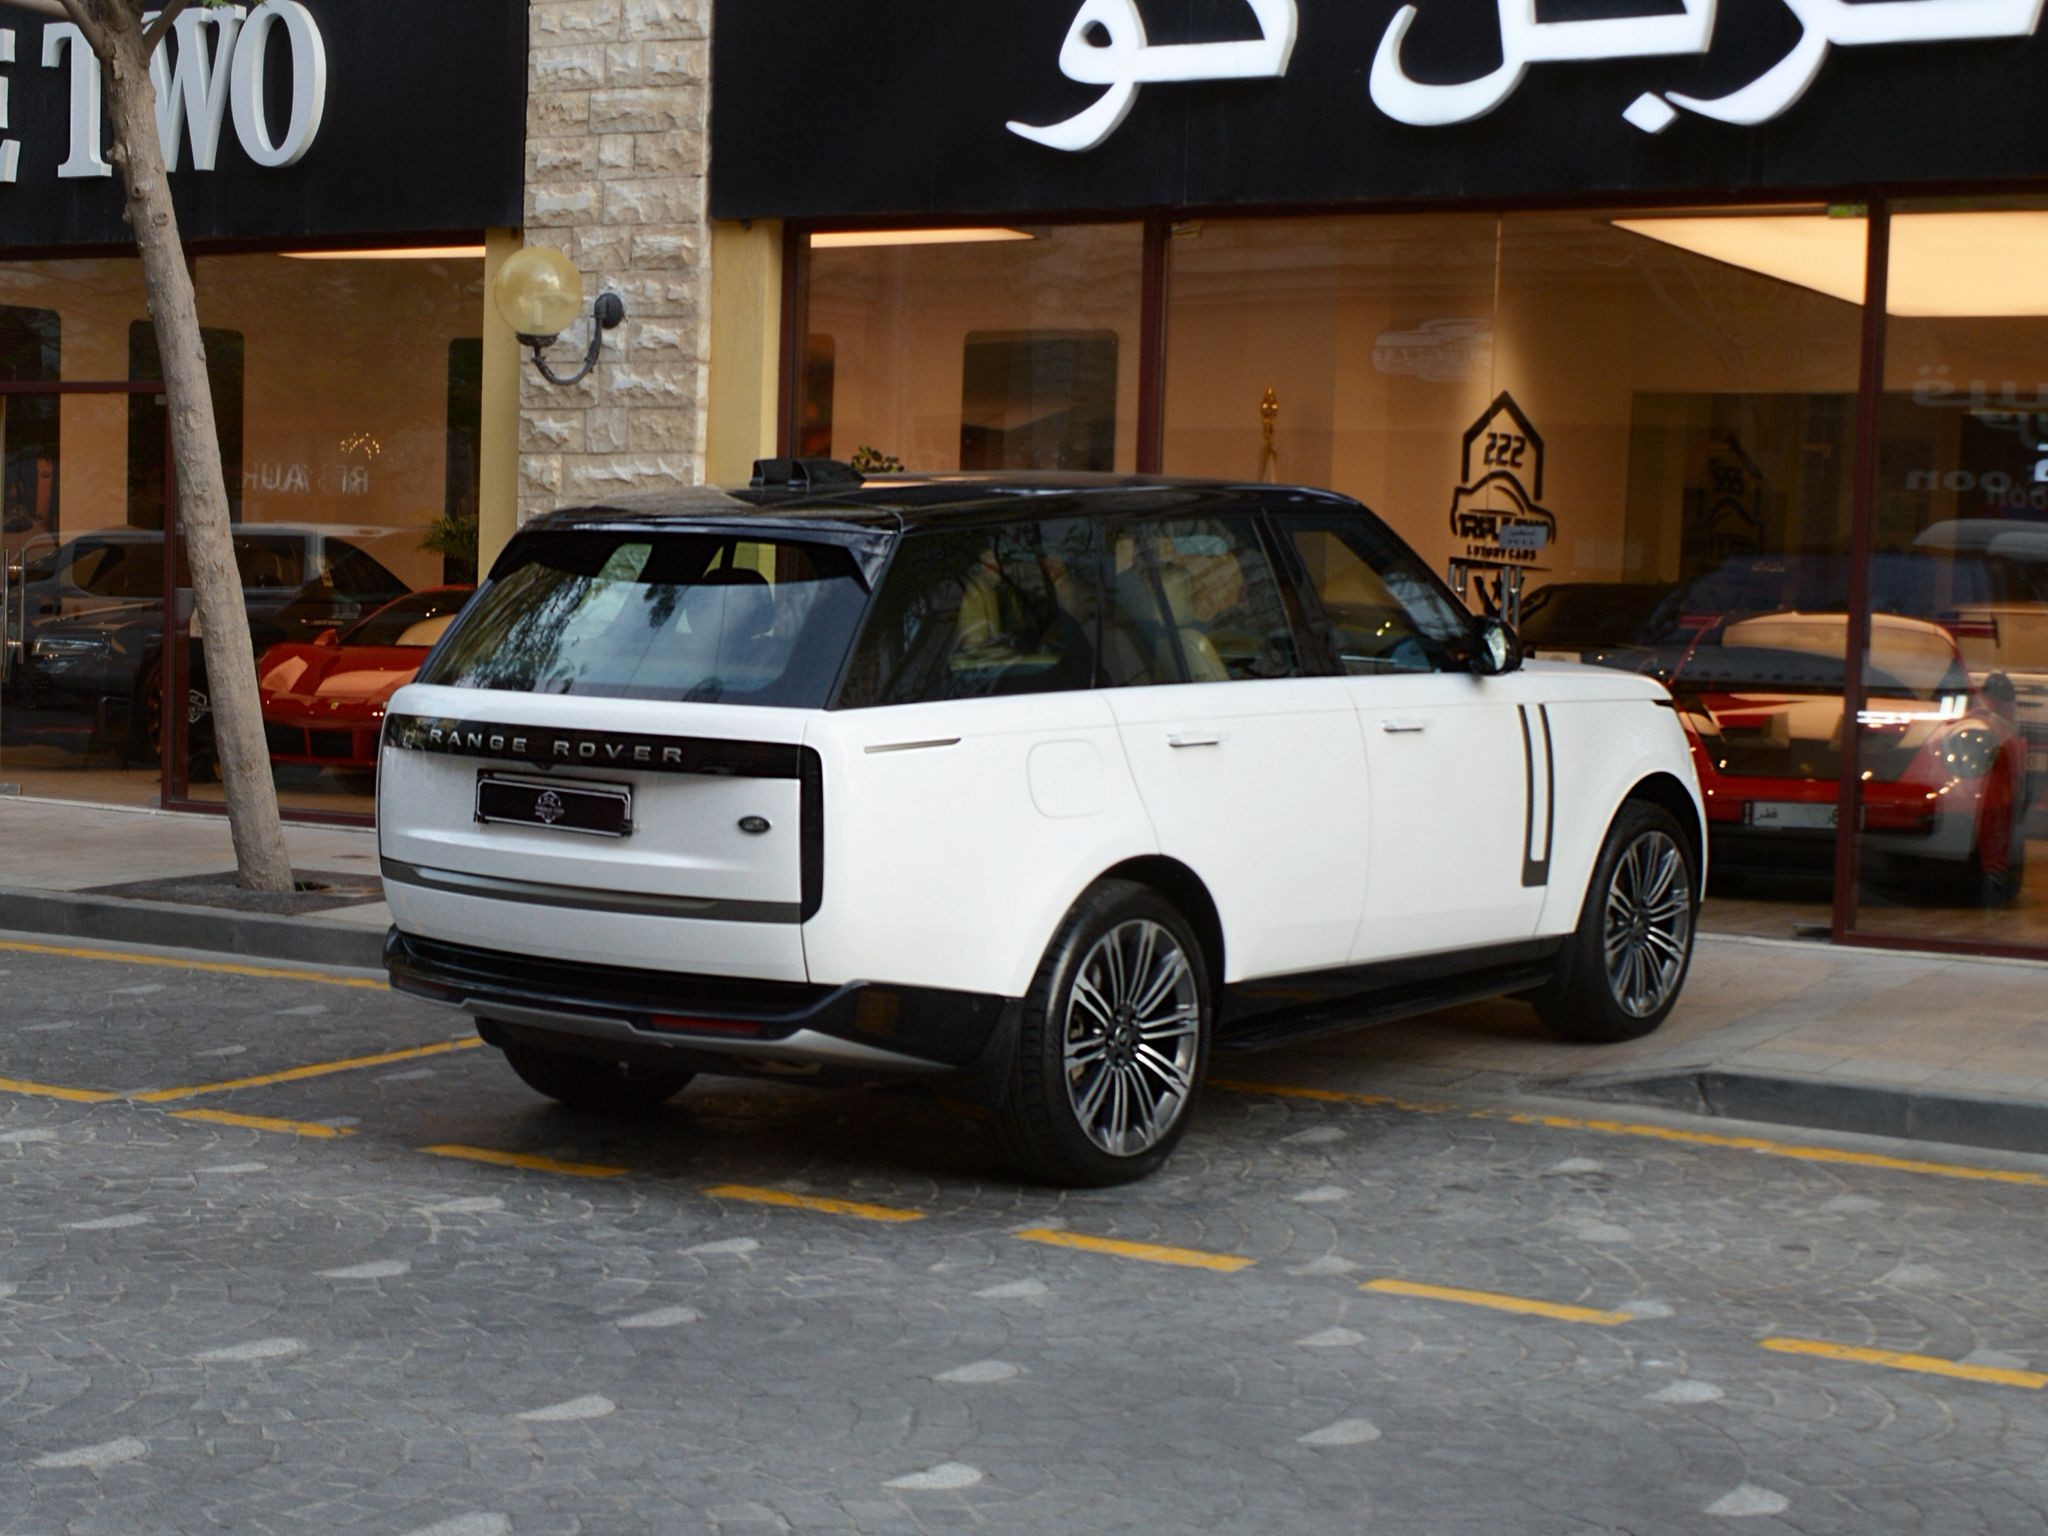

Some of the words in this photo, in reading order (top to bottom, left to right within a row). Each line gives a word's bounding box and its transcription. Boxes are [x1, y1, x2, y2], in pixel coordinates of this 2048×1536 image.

[42, 0, 327, 179] TWO
[1484, 432, 1526, 469] 222
[428, 728, 527, 754] RANGE
[553, 740, 684, 764] ROVER
